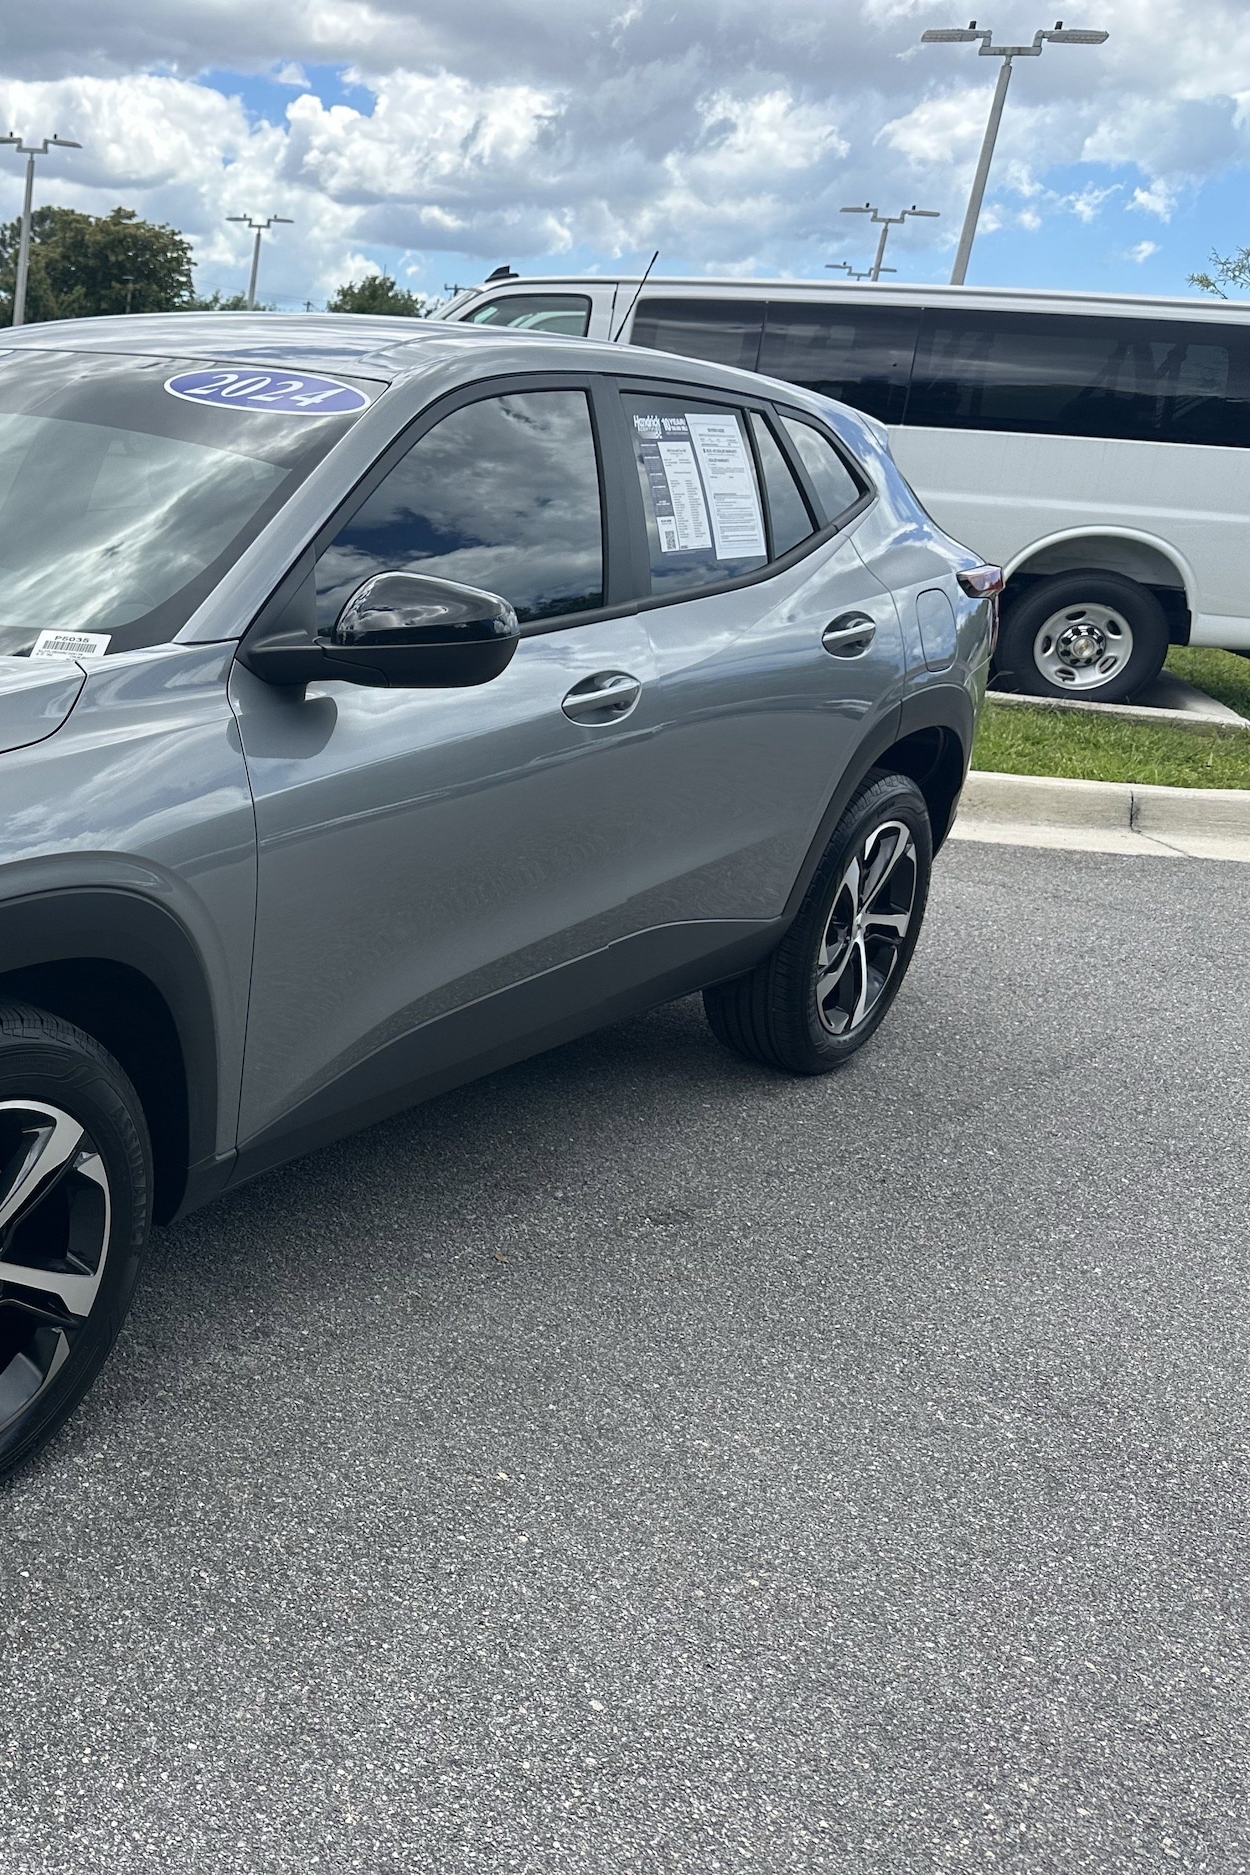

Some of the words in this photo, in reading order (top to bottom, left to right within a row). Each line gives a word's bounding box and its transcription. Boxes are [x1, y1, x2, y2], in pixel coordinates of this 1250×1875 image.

[183, 373, 347, 407] 2024
[633, 414, 661, 428] Hendrick
[54, 635, 90, 643] P5035
